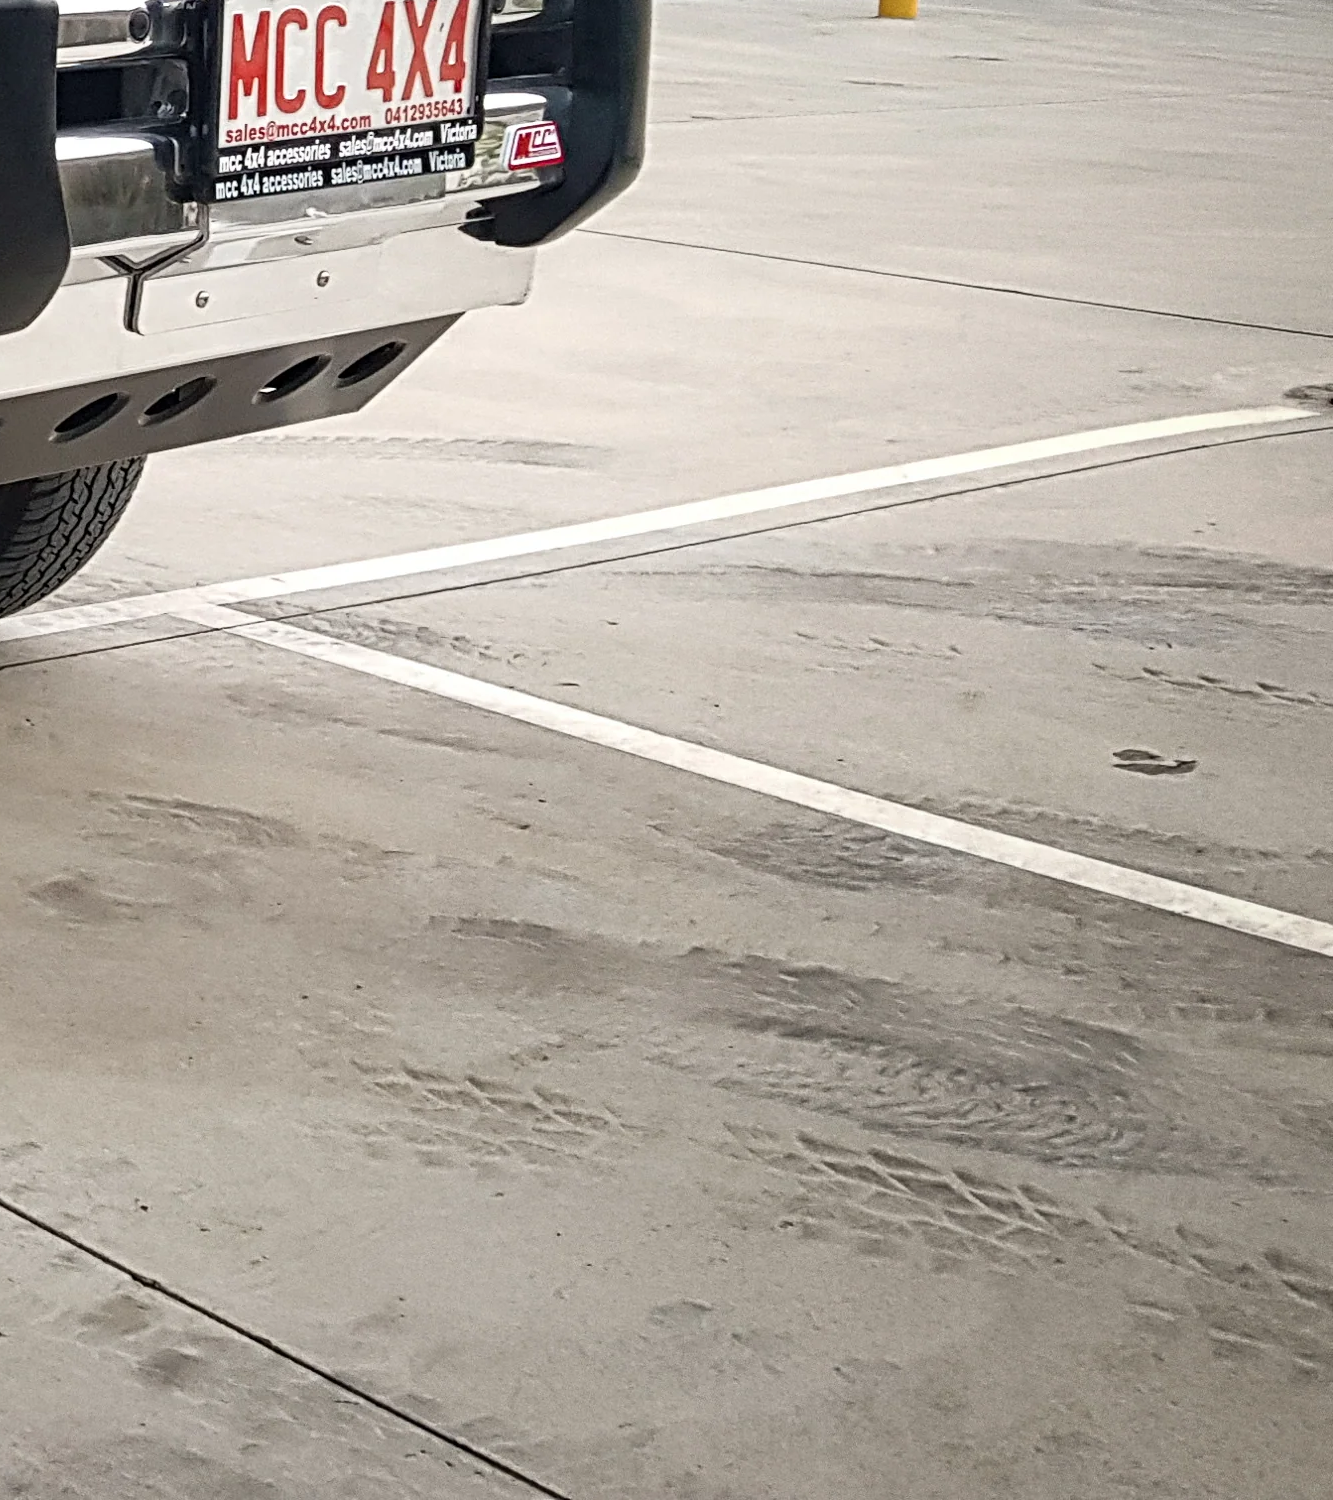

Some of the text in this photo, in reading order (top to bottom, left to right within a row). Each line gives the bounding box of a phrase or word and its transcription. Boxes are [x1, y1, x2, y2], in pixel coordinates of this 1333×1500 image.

[227, 3, 348, 121] MCC
[218, 119, 478, 174] mcc 4x4 accessories sales@mcc4x4.com Victoria
[224, 97, 464, 144] sales@mcc4x4.com 0412935643
[513, 128, 558, 161] MCC
[215, 147, 466, 200] mcc 4x4 accessories sales@mcc4x4.com Victoria
